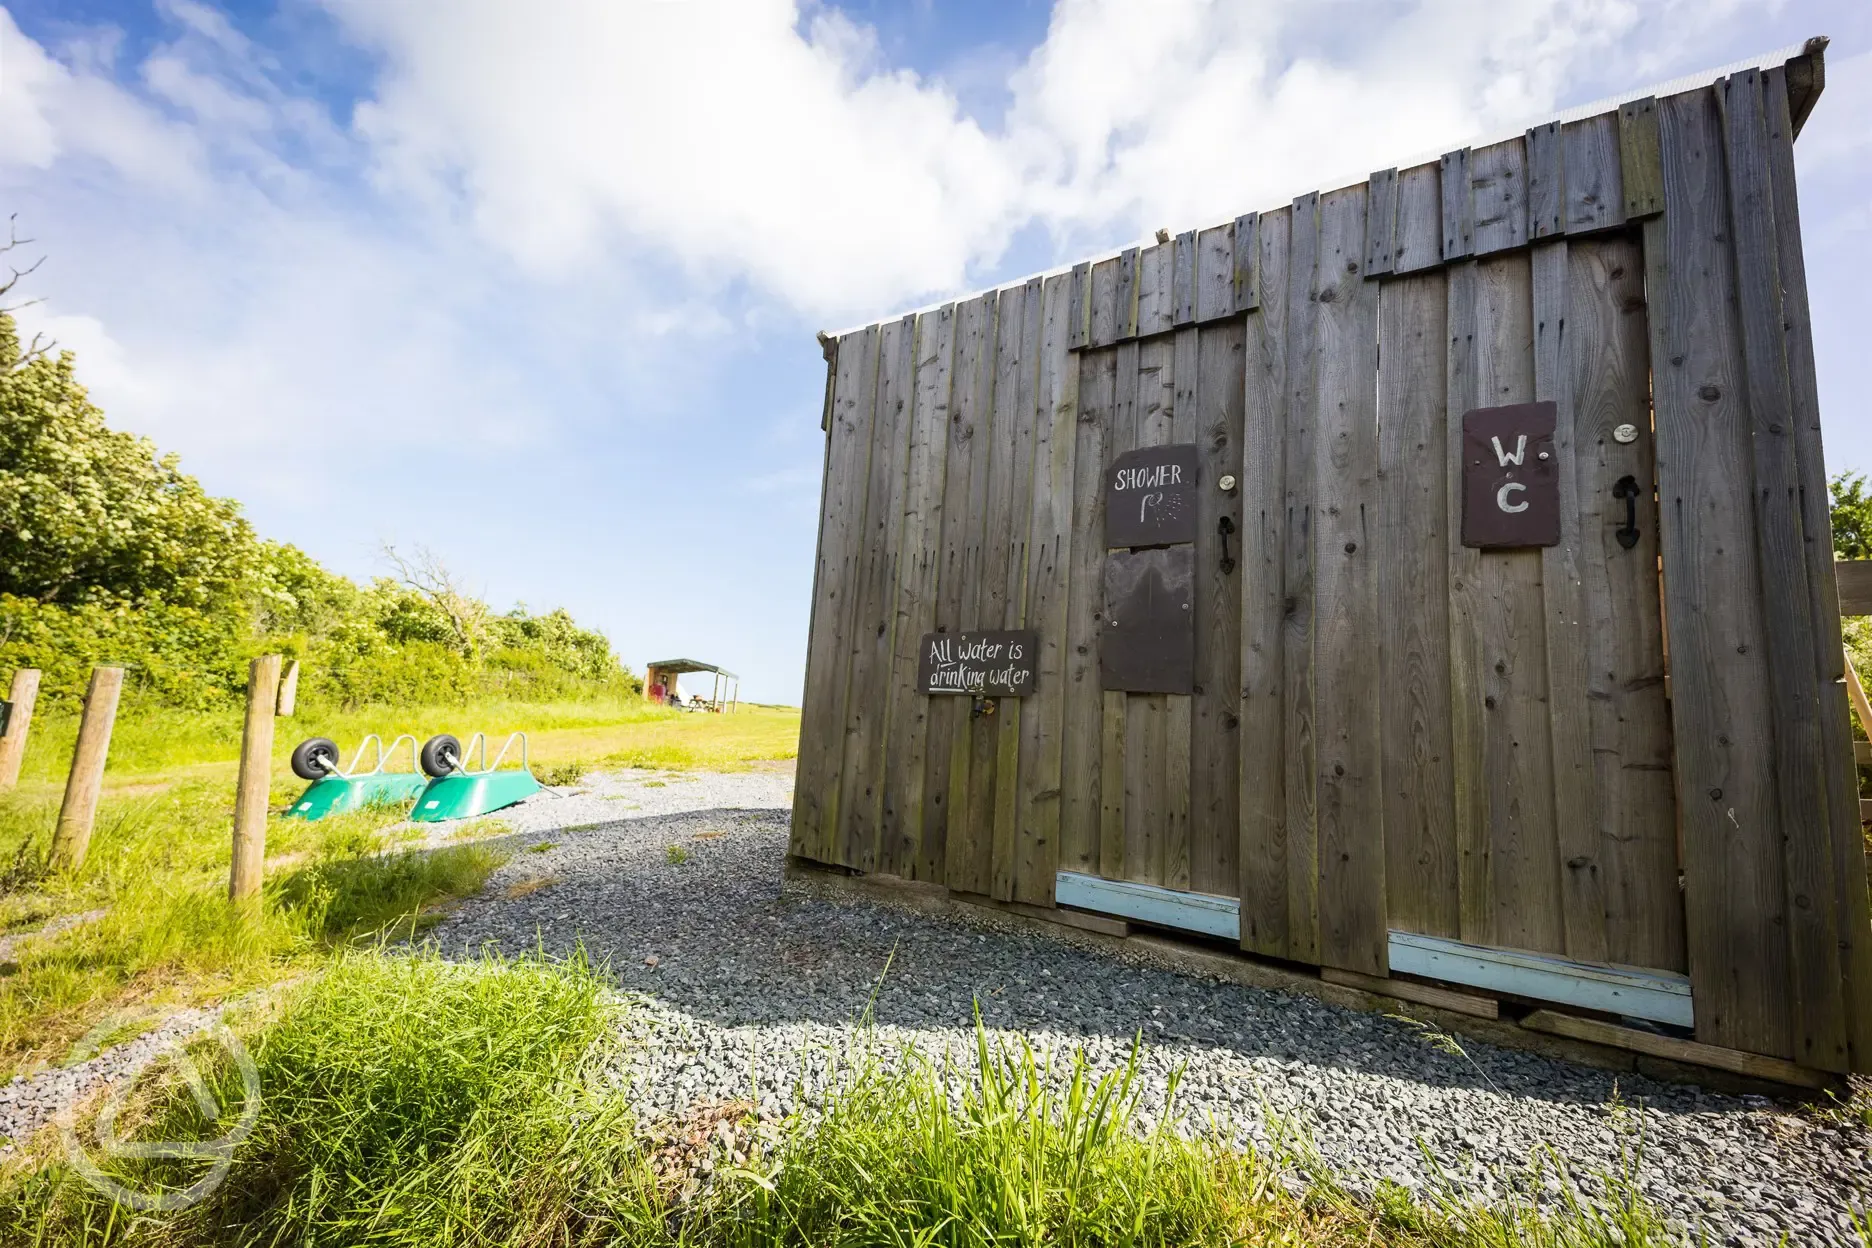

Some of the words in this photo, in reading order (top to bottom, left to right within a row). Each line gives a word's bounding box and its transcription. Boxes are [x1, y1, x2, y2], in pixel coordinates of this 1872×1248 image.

[1491, 435, 1527, 467] W
[1114, 464, 1182, 491] SHOWER
[1496, 482, 1529, 514] C
[929, 638, 953, 664] All
[958, 638, 1003, 662] water
[1008, 640, 1023, 660] is
[989, 663, 1030, 687] water
